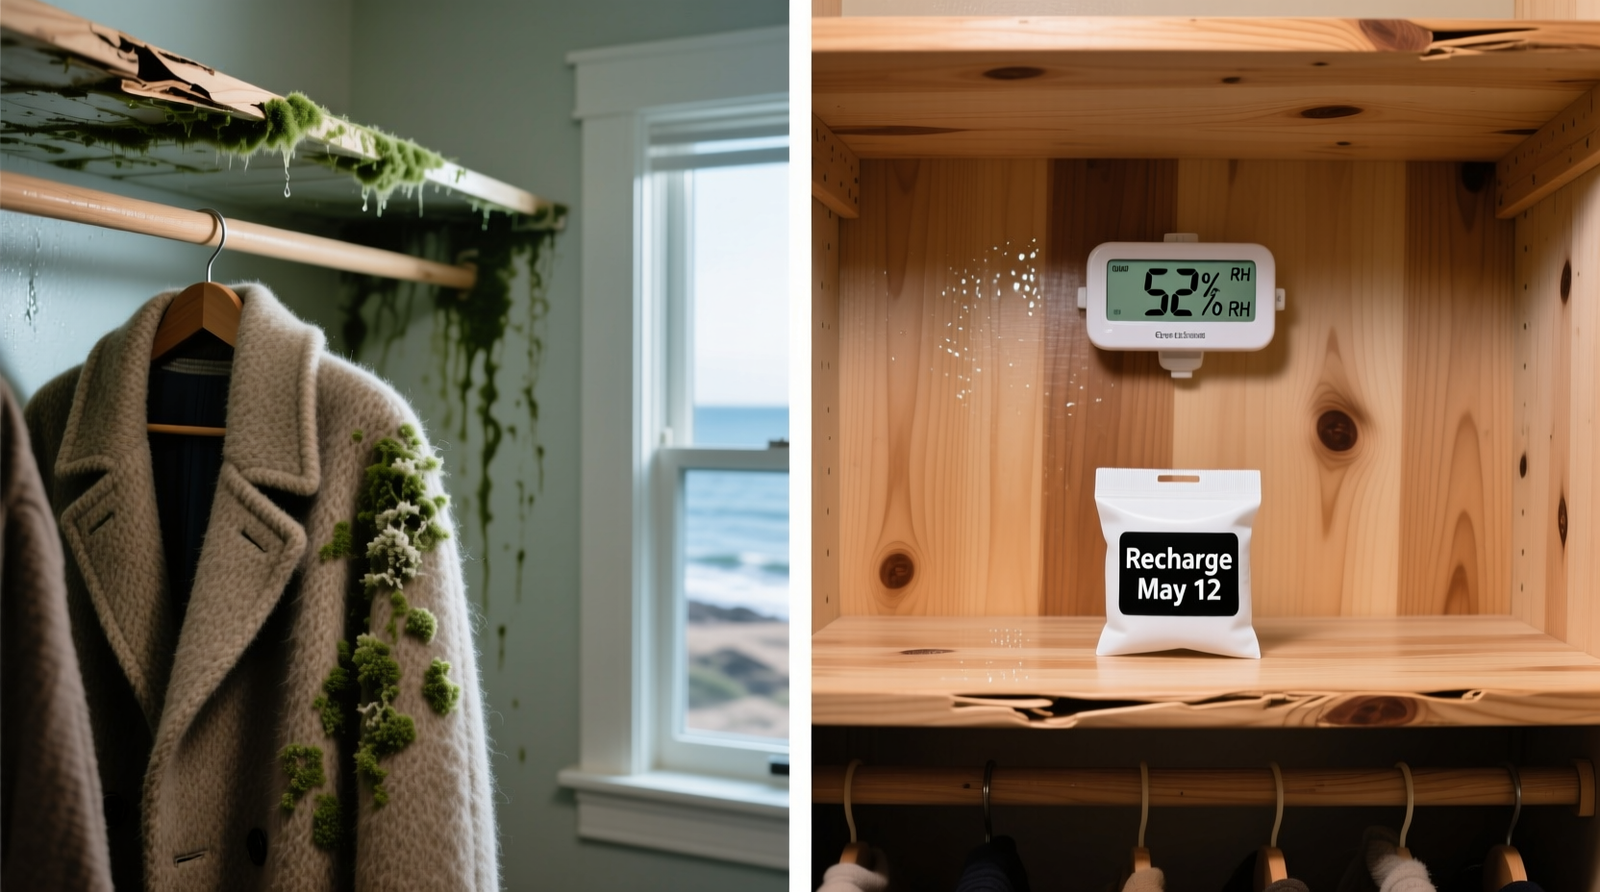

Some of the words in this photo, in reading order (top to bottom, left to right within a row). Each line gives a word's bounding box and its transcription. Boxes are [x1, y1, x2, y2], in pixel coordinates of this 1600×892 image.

[1230, 267, 1251, 282] RH
[1228, 301, 1251, 317] RH
[1126, 546, 1233, 576] Recharge
[1137, 577, 1187, 607] May
[1194, 578, 1222, 601] 12
